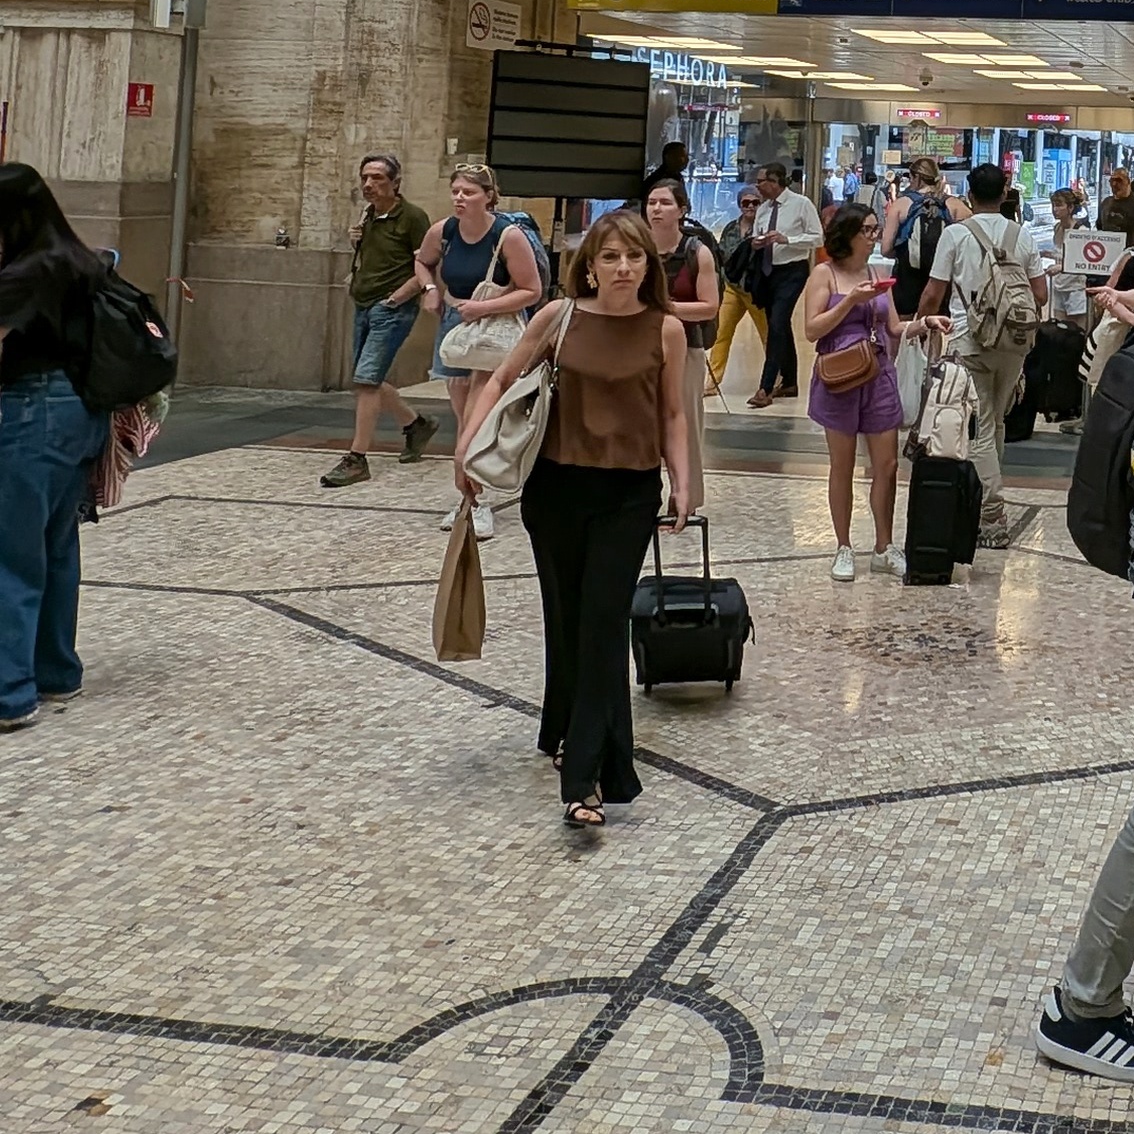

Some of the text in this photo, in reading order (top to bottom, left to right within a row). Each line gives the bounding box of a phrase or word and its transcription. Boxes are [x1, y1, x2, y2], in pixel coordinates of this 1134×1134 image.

[636, 46, 728, 89] SEPHORA
[1074, 262, 1110, 272] NO ENTRY
